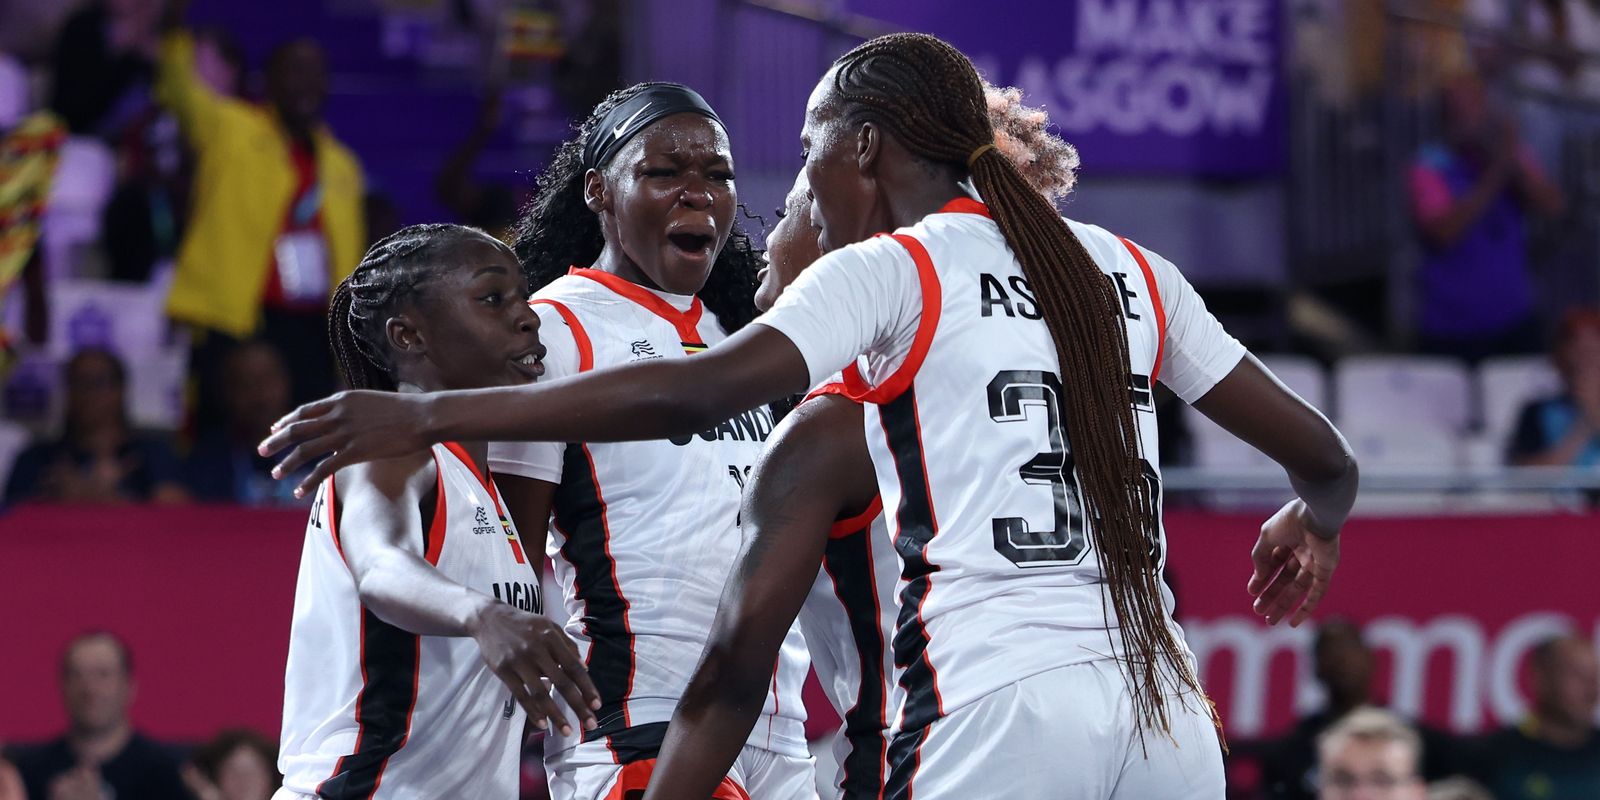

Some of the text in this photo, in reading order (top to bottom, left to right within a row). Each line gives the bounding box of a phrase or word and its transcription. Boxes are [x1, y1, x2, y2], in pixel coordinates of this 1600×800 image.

[1075, 0, 1268, 61] MAKE
[472, 526, 496, 535] GOFERE
[492, 581, 544, 615] UGAN
